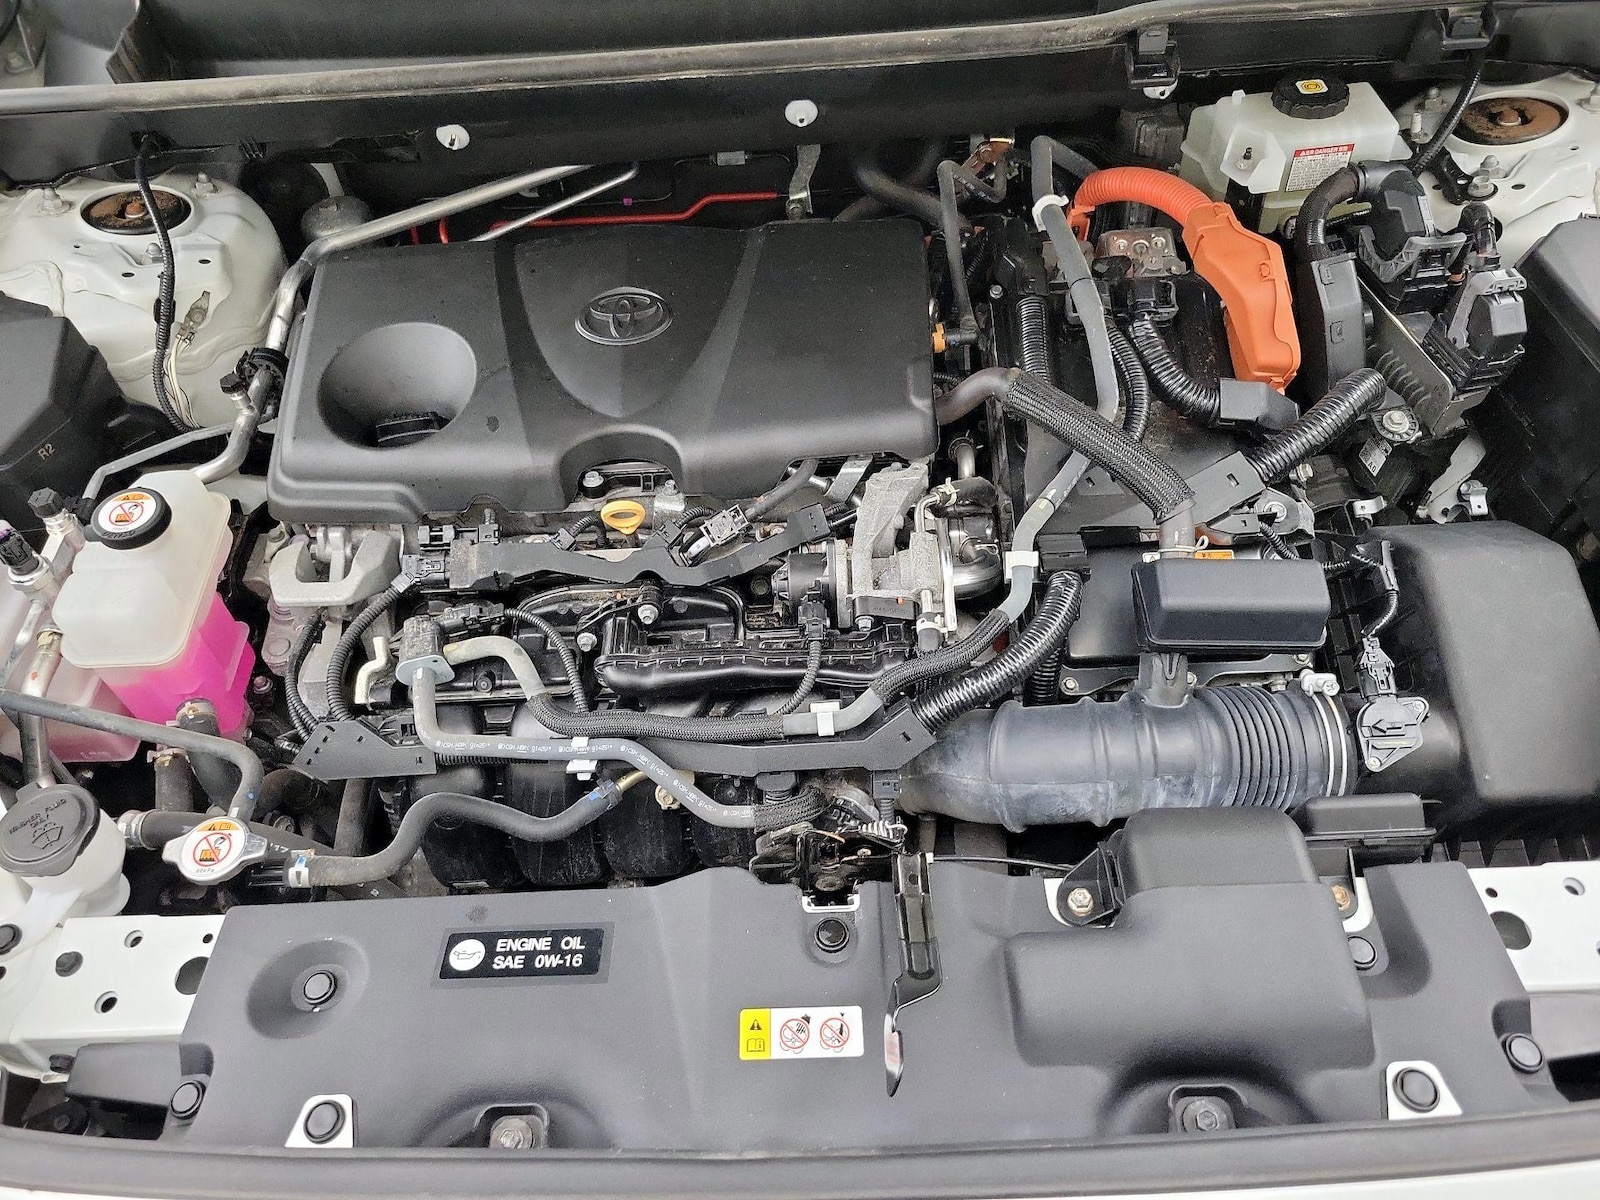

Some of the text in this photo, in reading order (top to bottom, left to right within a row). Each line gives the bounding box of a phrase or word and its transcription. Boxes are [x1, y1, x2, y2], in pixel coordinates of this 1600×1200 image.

[38, 443, 55, 460] R2
[496, 935, 586, 952] ENGINE OIL
[492, 953, 583, 970] SAE 0W-16
